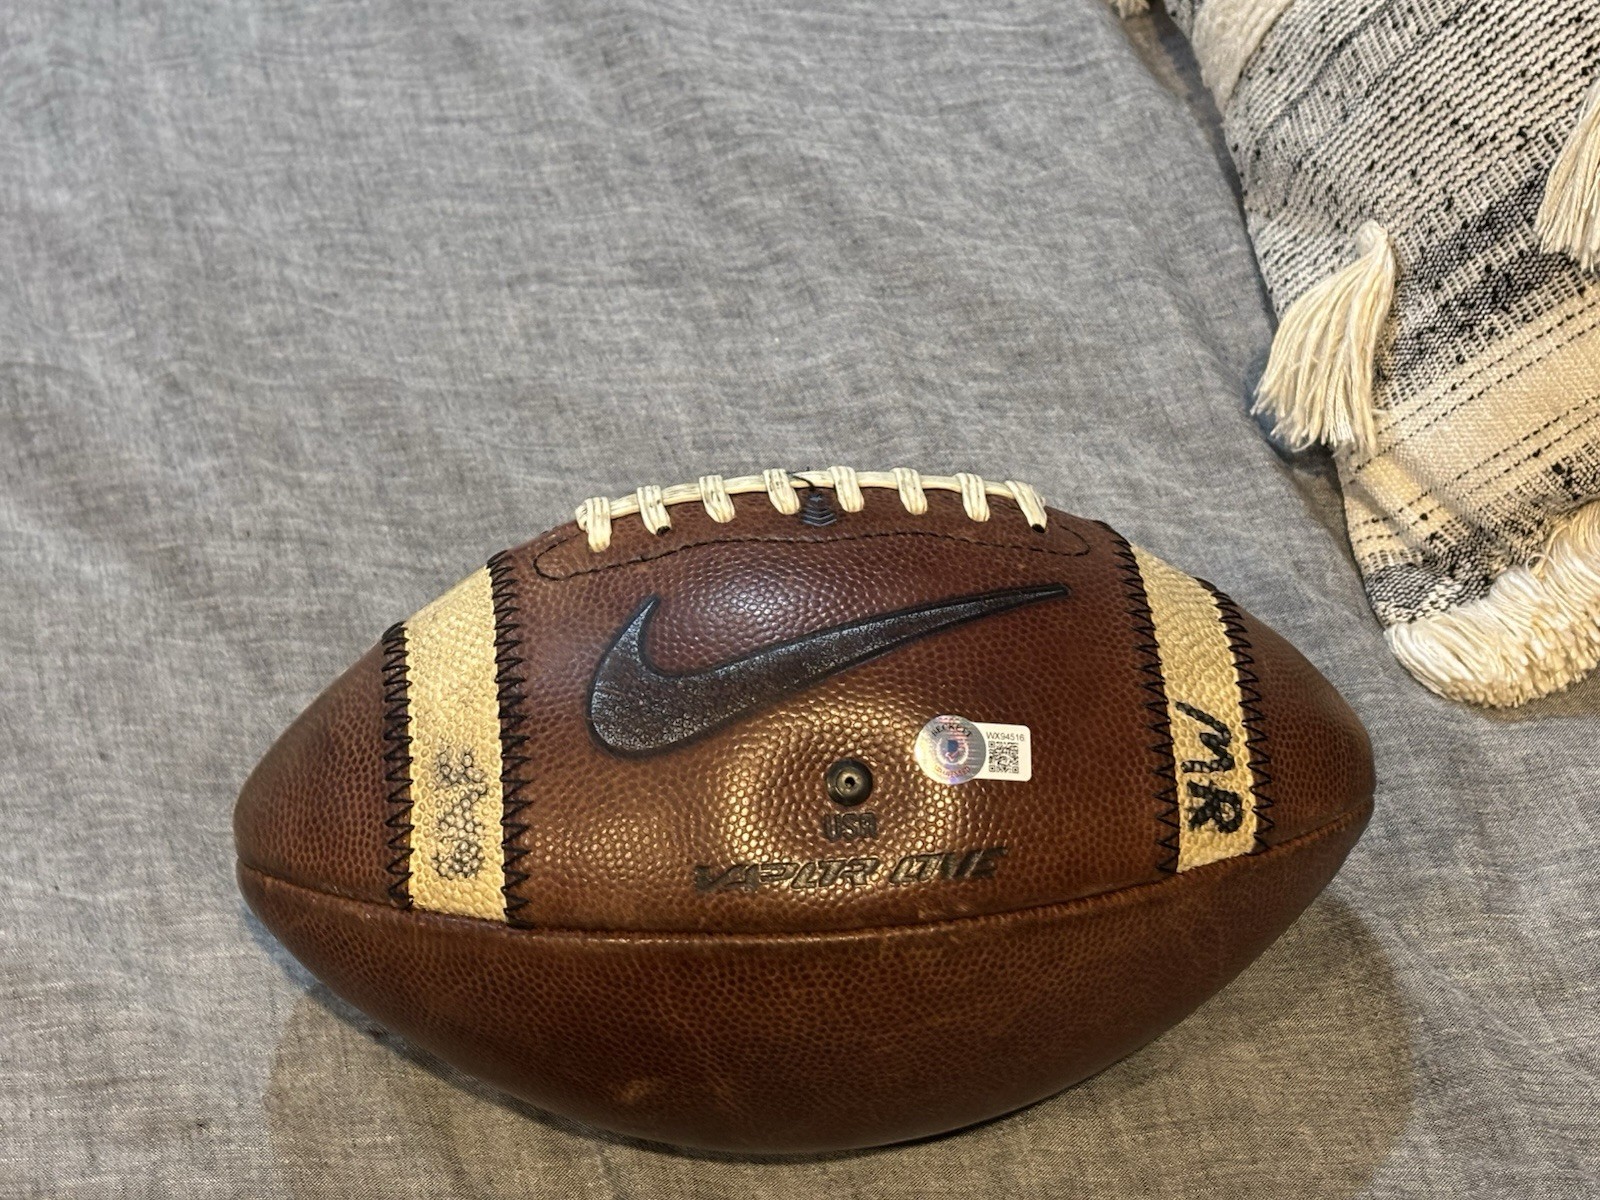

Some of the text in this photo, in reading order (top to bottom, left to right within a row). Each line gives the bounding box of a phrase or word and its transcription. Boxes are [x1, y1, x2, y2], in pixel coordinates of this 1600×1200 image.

[986, 731, 1025, 741] WX94516
[1175, 701, 1243, 833] MR
[821, 812, 878, 841] USA
